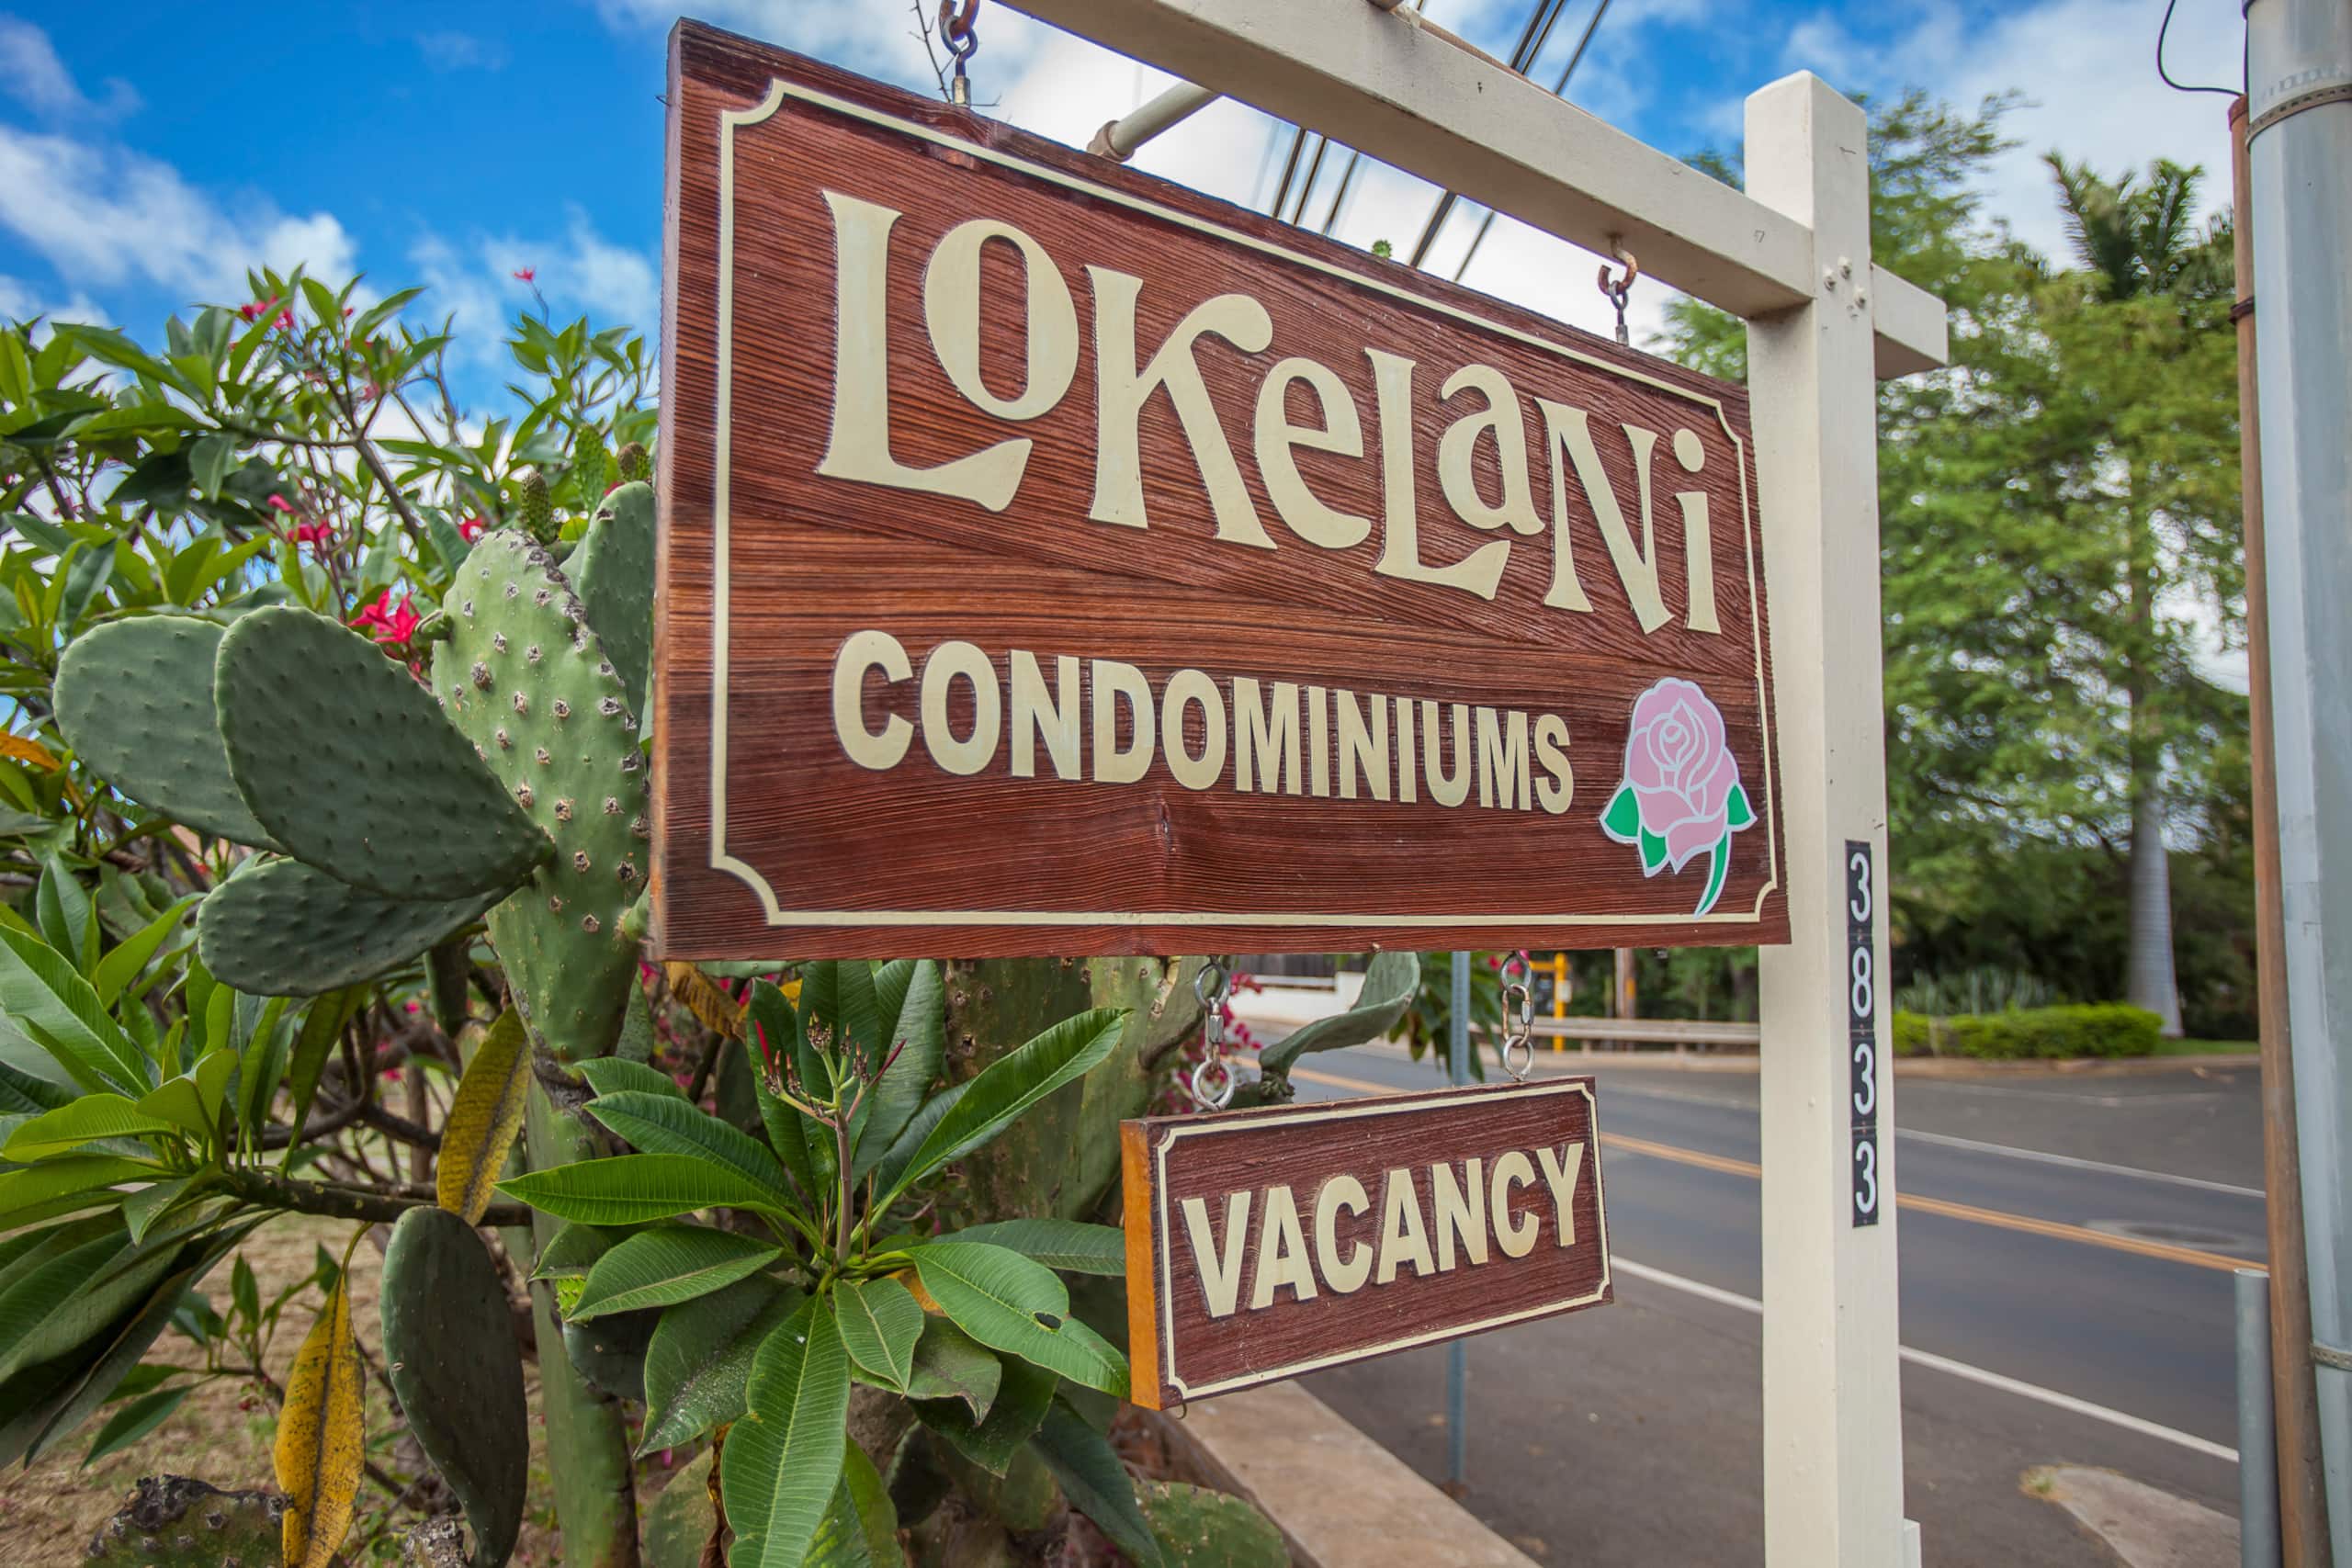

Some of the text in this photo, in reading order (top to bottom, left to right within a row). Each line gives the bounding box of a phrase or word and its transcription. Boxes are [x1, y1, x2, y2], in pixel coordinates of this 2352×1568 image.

[832, 630, 1575, 815] CONDOMINIUMS
[1849, 852, 1876, 1214] 3833
[1182, 1143, 1584, 1317] VACANCY
